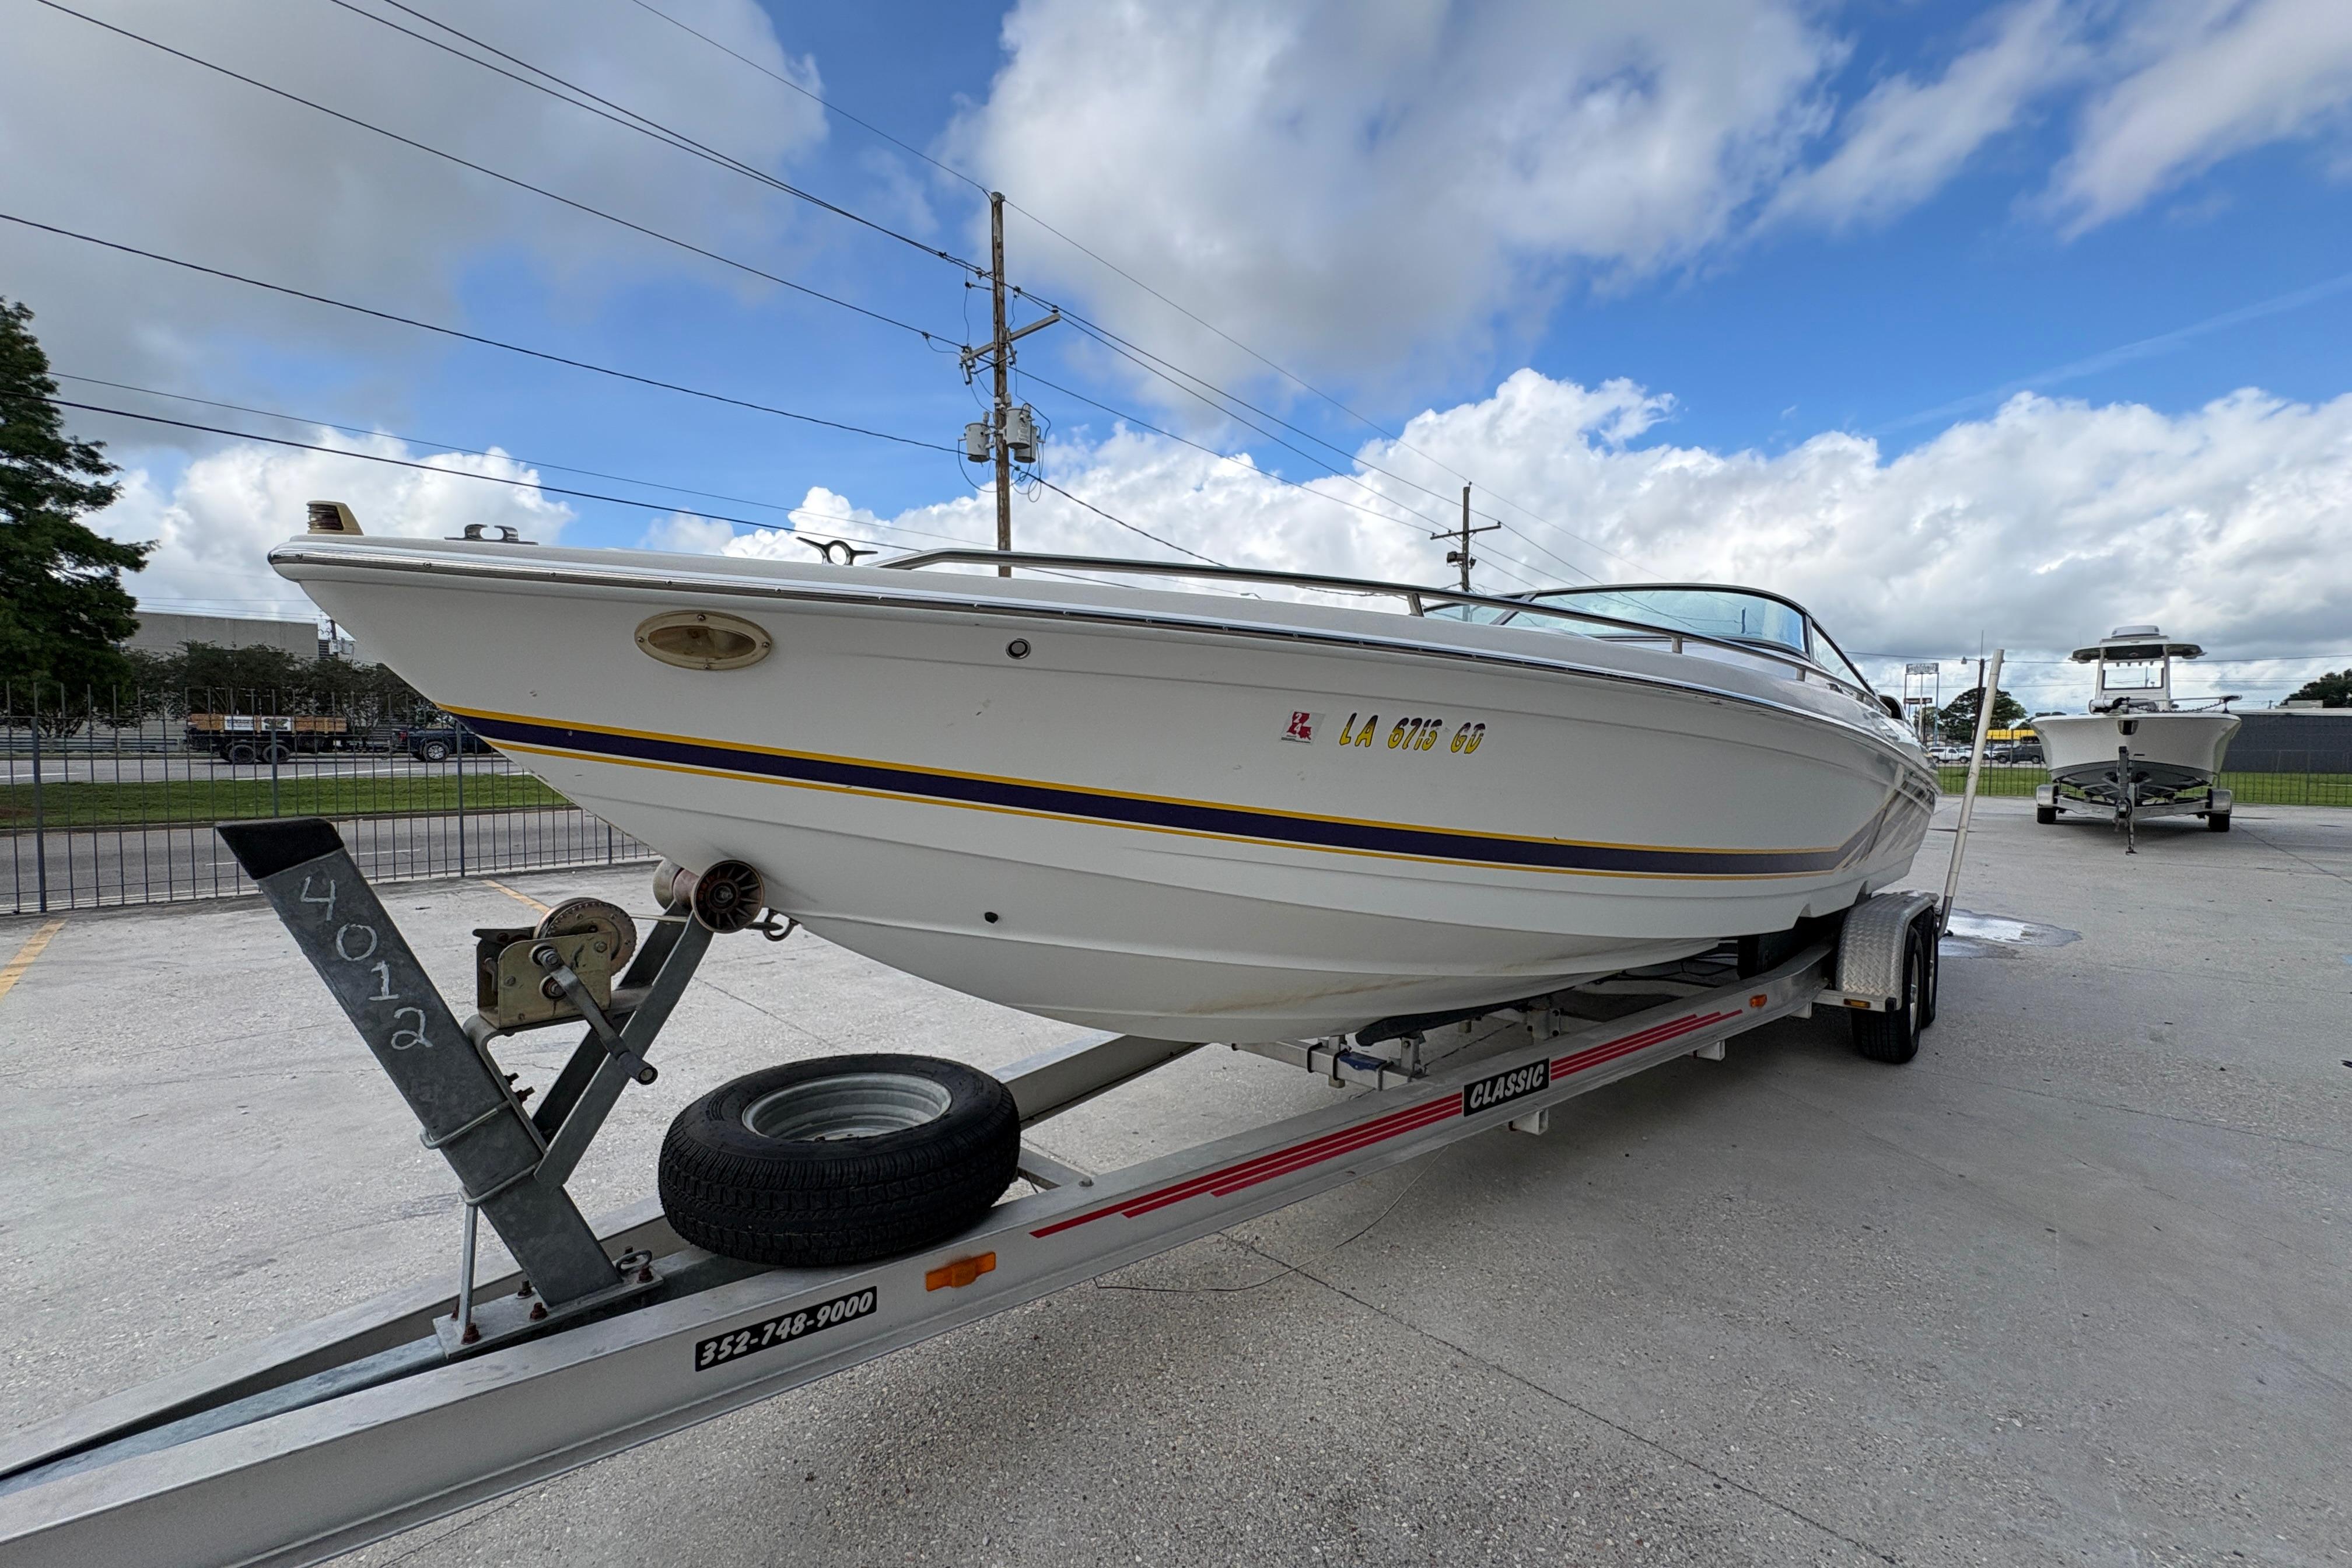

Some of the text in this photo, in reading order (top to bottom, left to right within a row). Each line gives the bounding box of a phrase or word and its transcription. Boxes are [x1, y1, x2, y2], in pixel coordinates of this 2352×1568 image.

[1339, 712, 1378, 747] LA
[1469, 1063, 1544, 1109] CLASSIC
[700, 1292, 874, 1366] 352-748-9000
